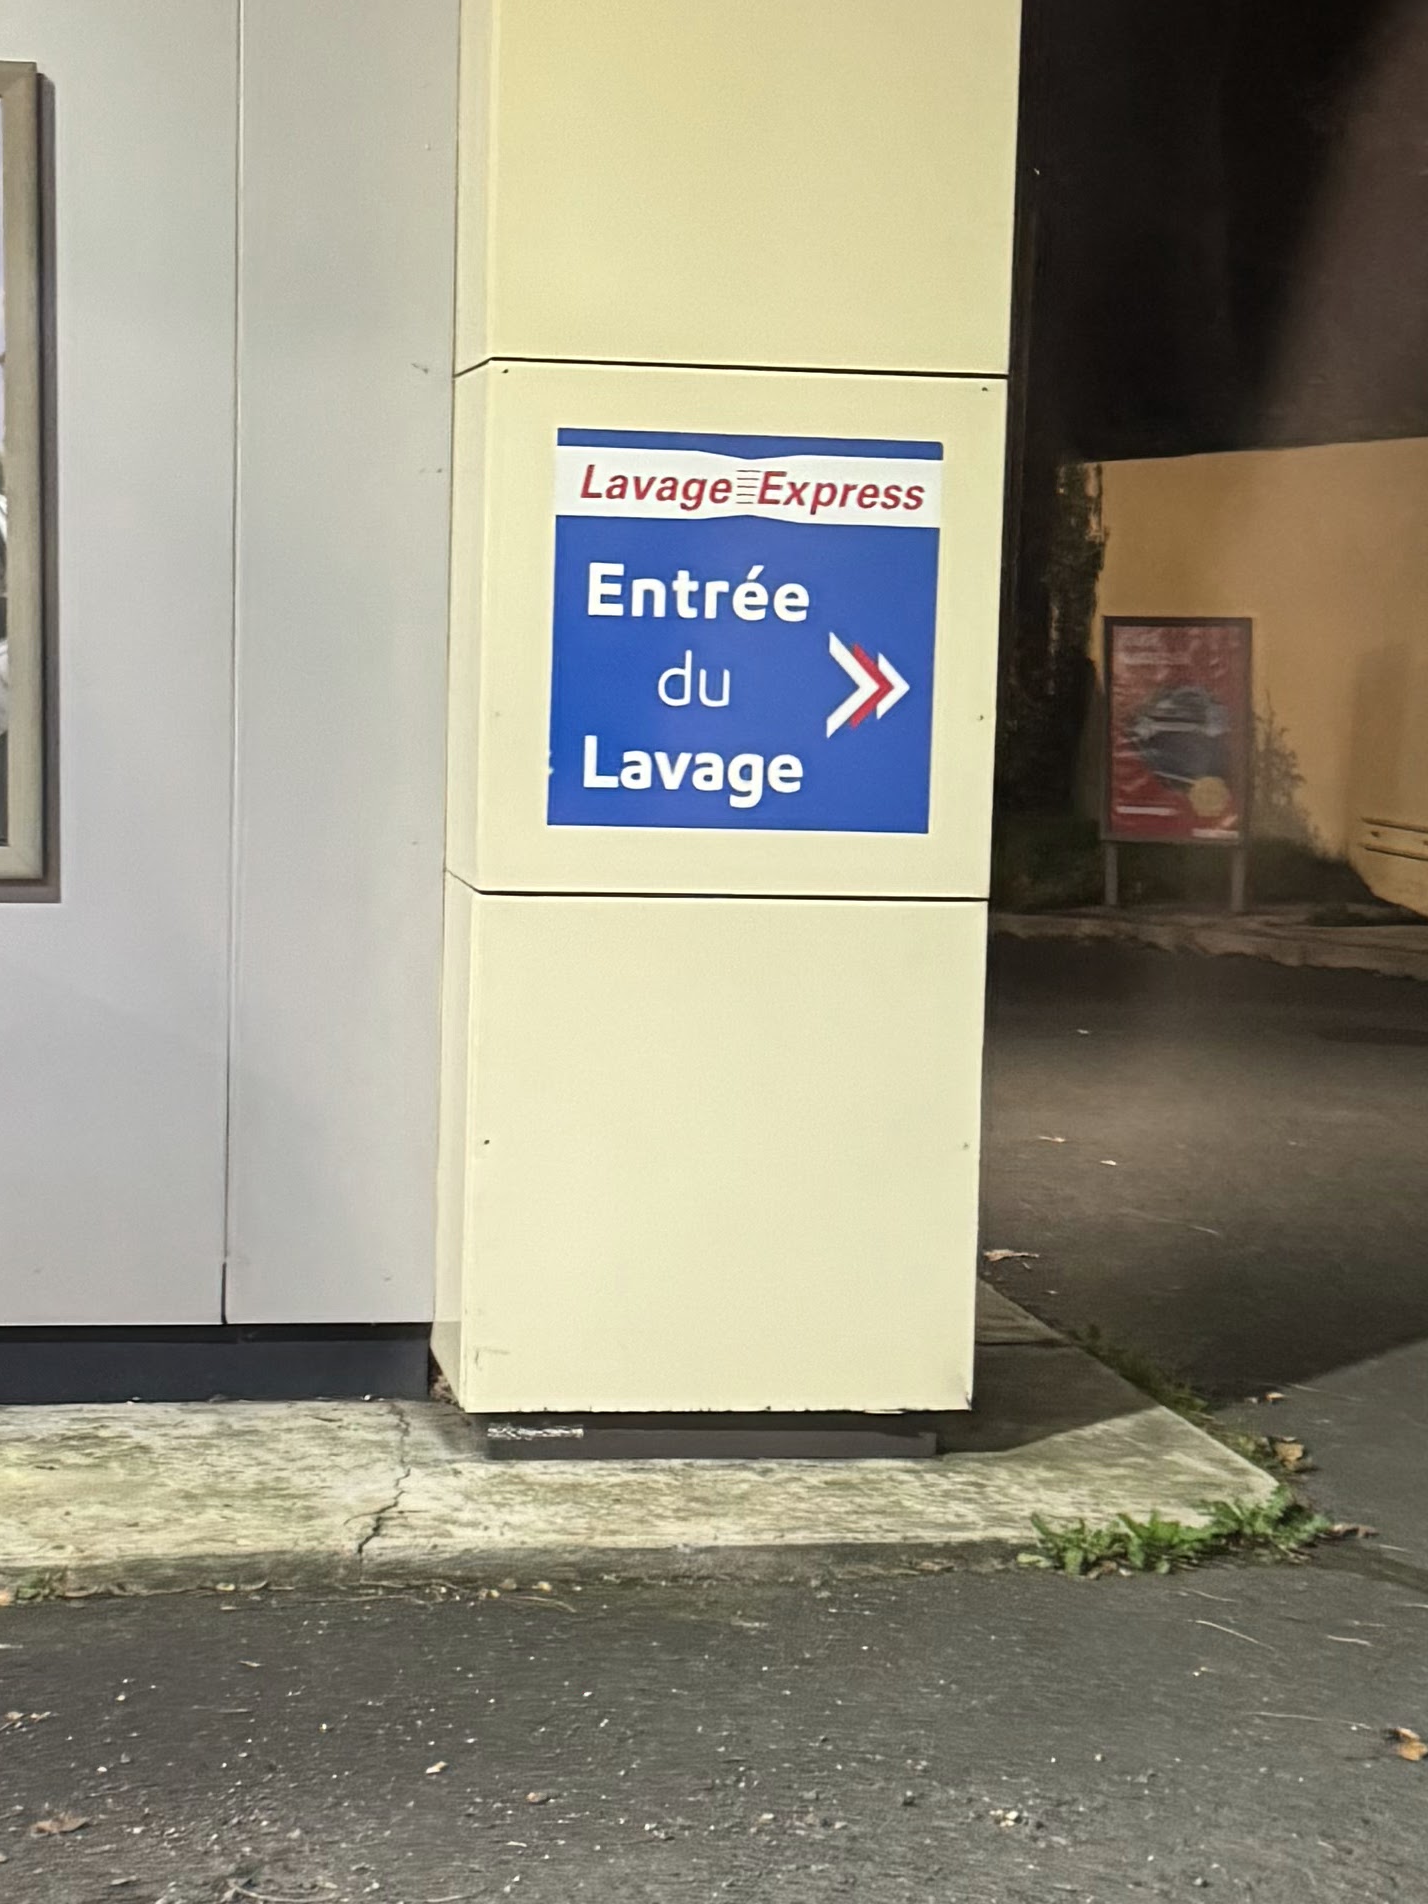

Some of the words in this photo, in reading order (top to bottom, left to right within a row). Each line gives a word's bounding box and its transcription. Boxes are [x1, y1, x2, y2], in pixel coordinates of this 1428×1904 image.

[580, 464, 733, 511] Lavage
[757, 470, 926, 515] Express
[587, 562, 810, 622] Entrée
[657, 650, 730, 707] du
[583, 735, 803, 809] Lavage
